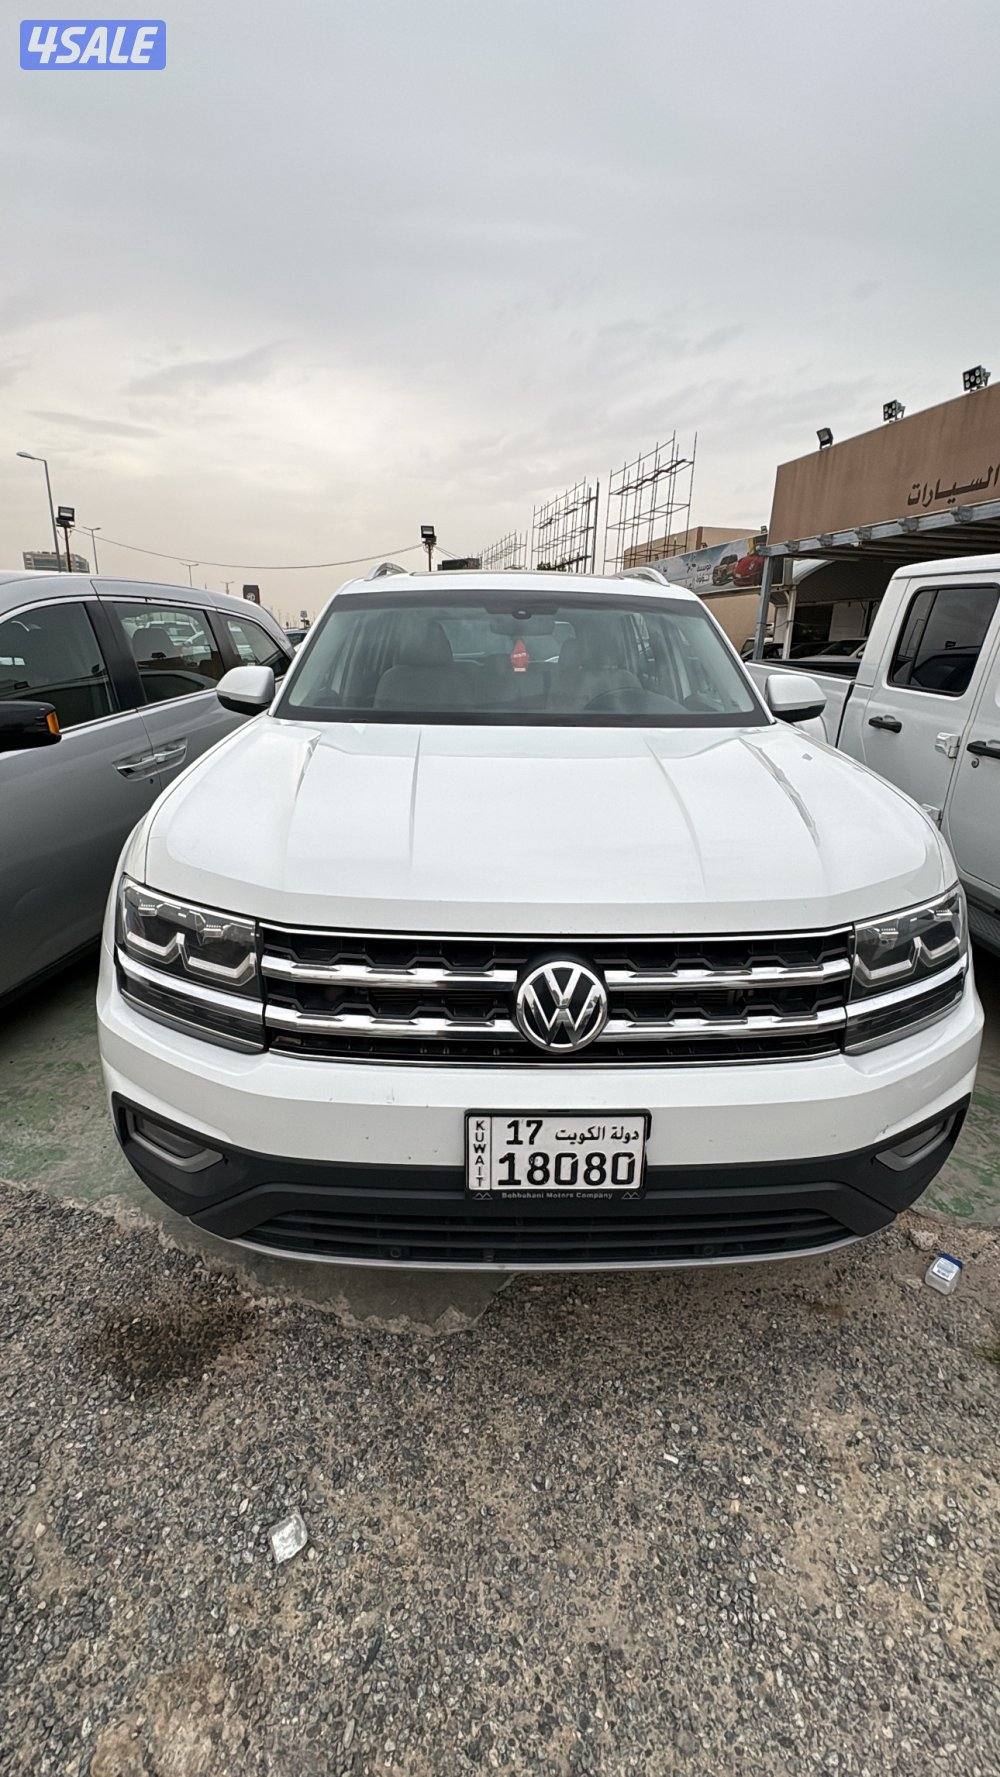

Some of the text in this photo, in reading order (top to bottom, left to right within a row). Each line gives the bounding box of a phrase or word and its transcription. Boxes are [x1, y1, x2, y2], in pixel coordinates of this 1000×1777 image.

[907, 463, 1000, 508] السيارات
[506, 1119, 543, 1145] 17
[555, 1125, 640, 1145] دولة الكويت
[473, 1120, 487, 1187] KUWAIT
[498, 1151, 636, 1186] 18080
[576, 1192, 613, 1200] Company
